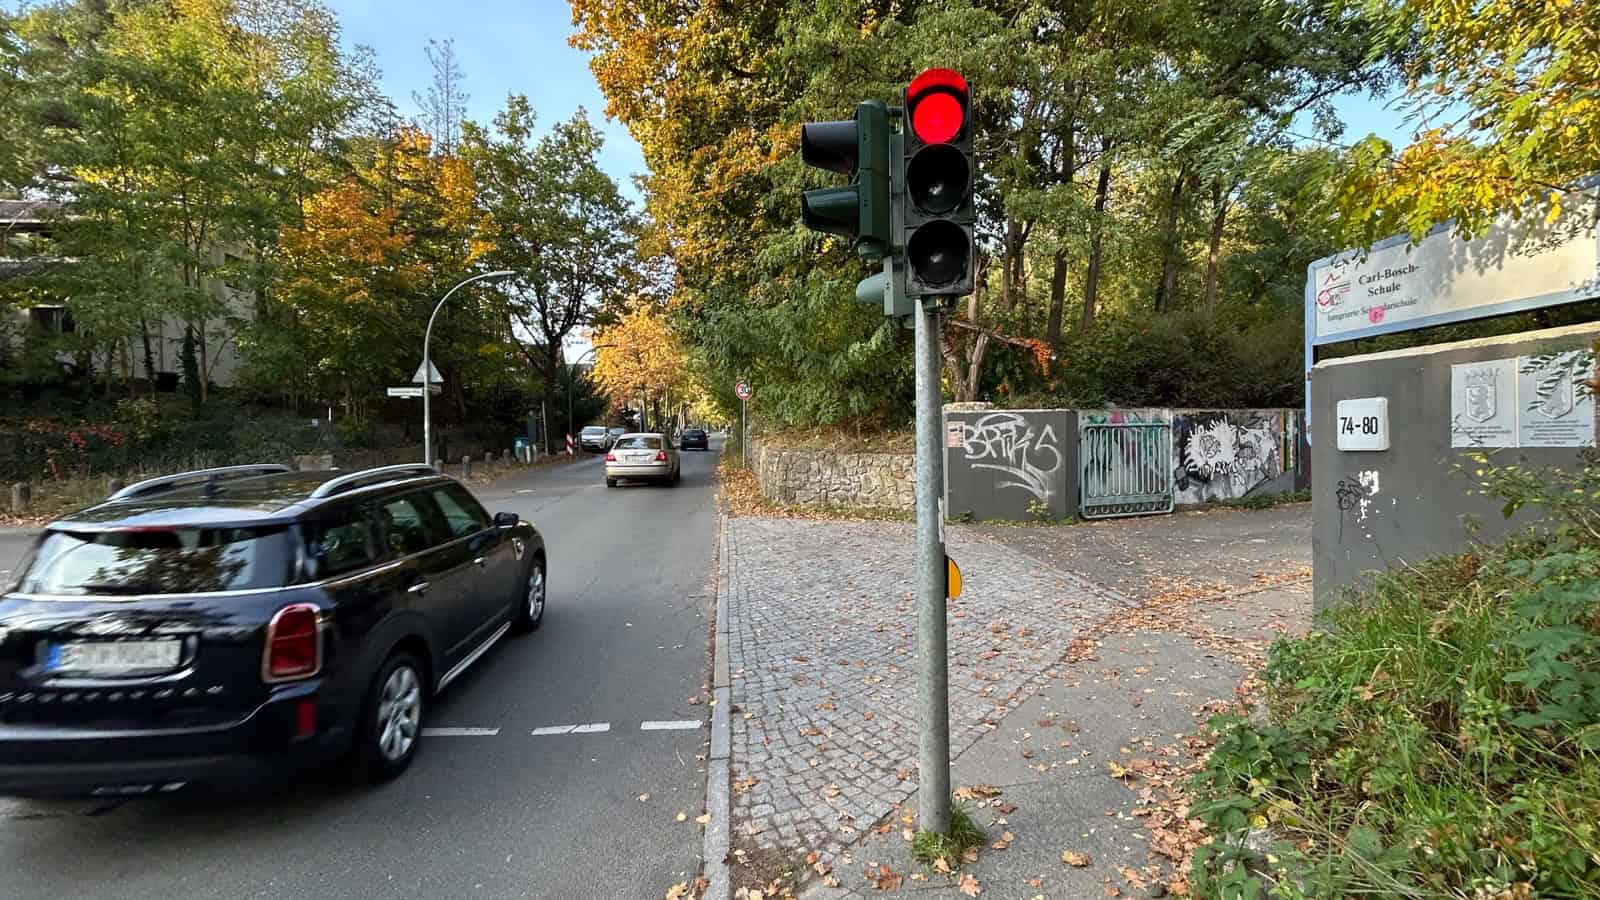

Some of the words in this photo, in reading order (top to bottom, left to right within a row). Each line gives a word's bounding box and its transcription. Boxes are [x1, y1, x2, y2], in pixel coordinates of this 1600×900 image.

[1358, 263, 1420, 285] Carl-Bosch-
[1367, 282, 1401, 297] Schule
[1340, 416, 1378, 435] 74-80
